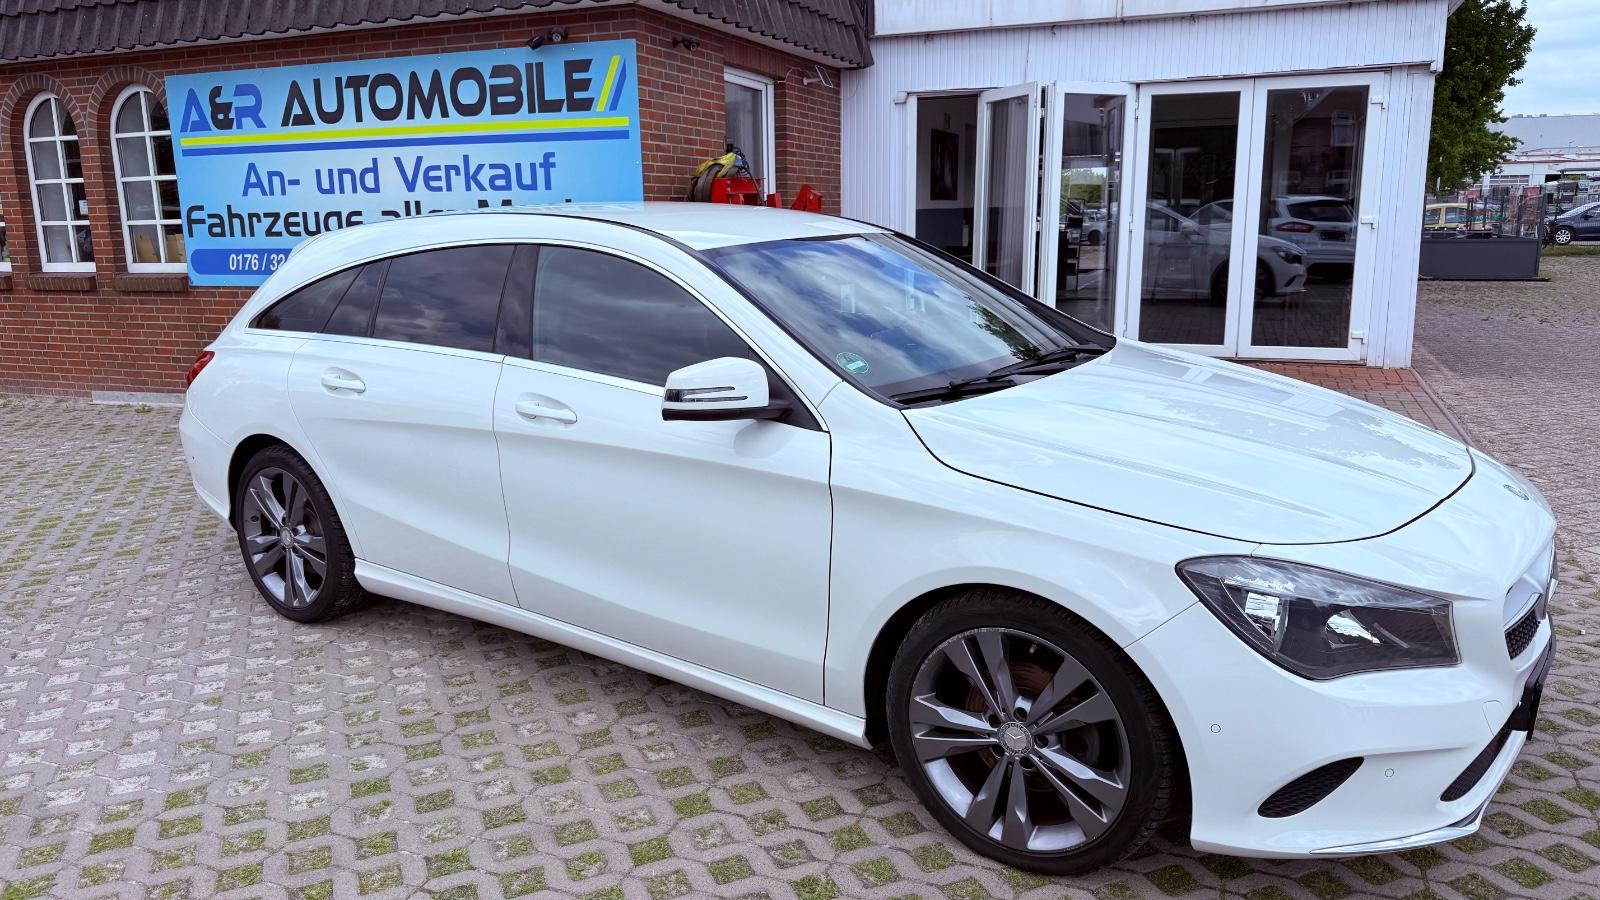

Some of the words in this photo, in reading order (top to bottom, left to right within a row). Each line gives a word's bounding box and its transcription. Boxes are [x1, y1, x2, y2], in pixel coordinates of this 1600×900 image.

[180, 84, 267, 132] A&R
[280, 58, 594, 127] AUTOMOBILE
[242, 162, 301, 197] An-
[316, 157, 381, 194] und
[393, 152, 556, 193] Verkauf
[229, 253, 259, 271] 0176
